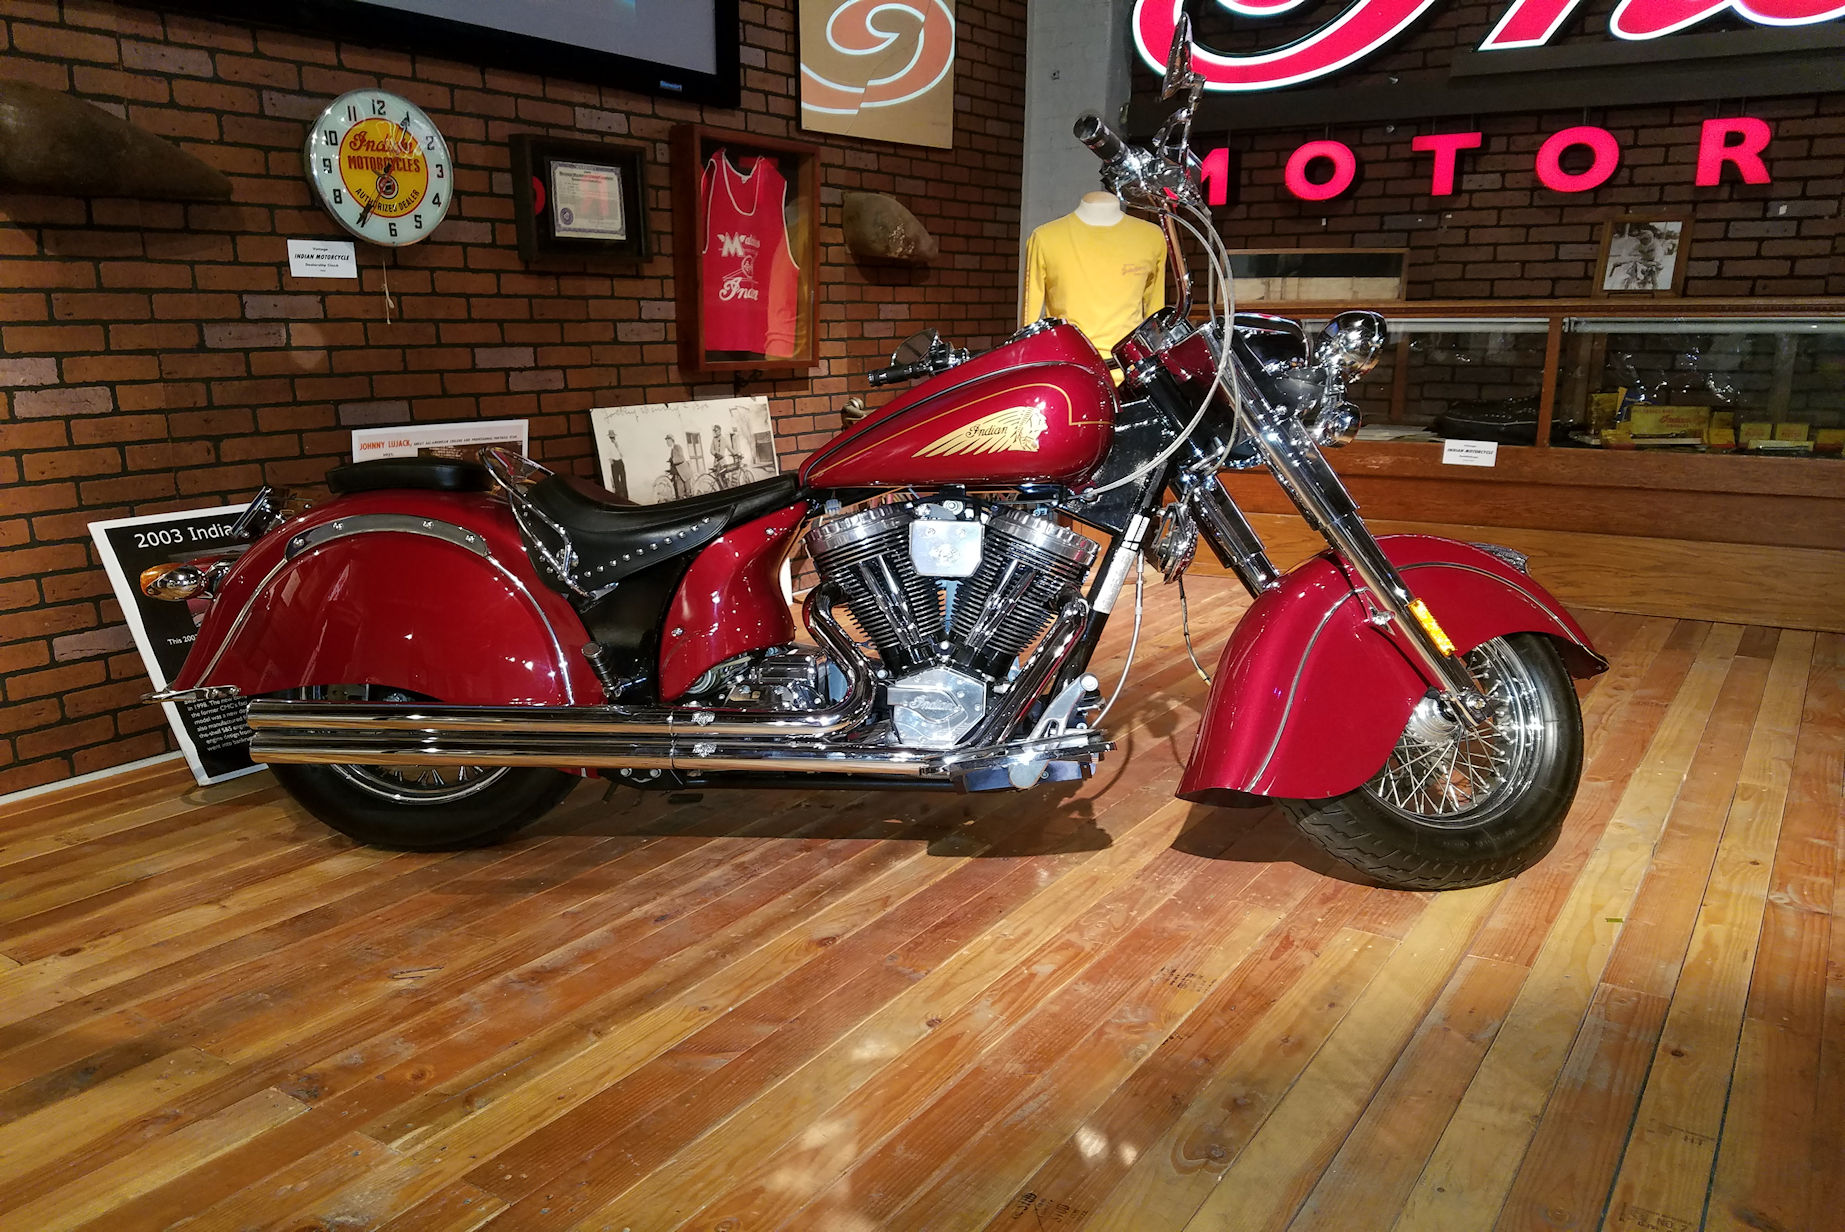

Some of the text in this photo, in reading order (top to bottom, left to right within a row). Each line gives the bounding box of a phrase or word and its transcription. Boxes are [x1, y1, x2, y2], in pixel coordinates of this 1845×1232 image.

[347, 105, 357, 122] 11
[372, 99, 386, 116] 12
[324, 130, 338, 146] 10
[426, 135, 435, 151] 2
[323, 158, 332, 174] 9
[347, 155, 421, 173] MOTORCYCLES
[435, 164, 444, 179] 3
[333, 188, 343, 205] 8
[355, 188, 420, 213] AUTHRIZED DEALER
[432, 192, 441, 207] 4
[388, 222, 398, 237] 6
[414, 214, 423, 230] 5
[965, 424, 1008, 439] Indian
[360, 440, 385, 451] JOHNNY
[134, 528, 183, 549] 2003
[166, 637, 182, 646] This
[909, 694, 953, 711] Indian
[200, 707, 219, 715] former
[194, 716, 211, 726] model
[197, 716, 243, 733] also manufactured
